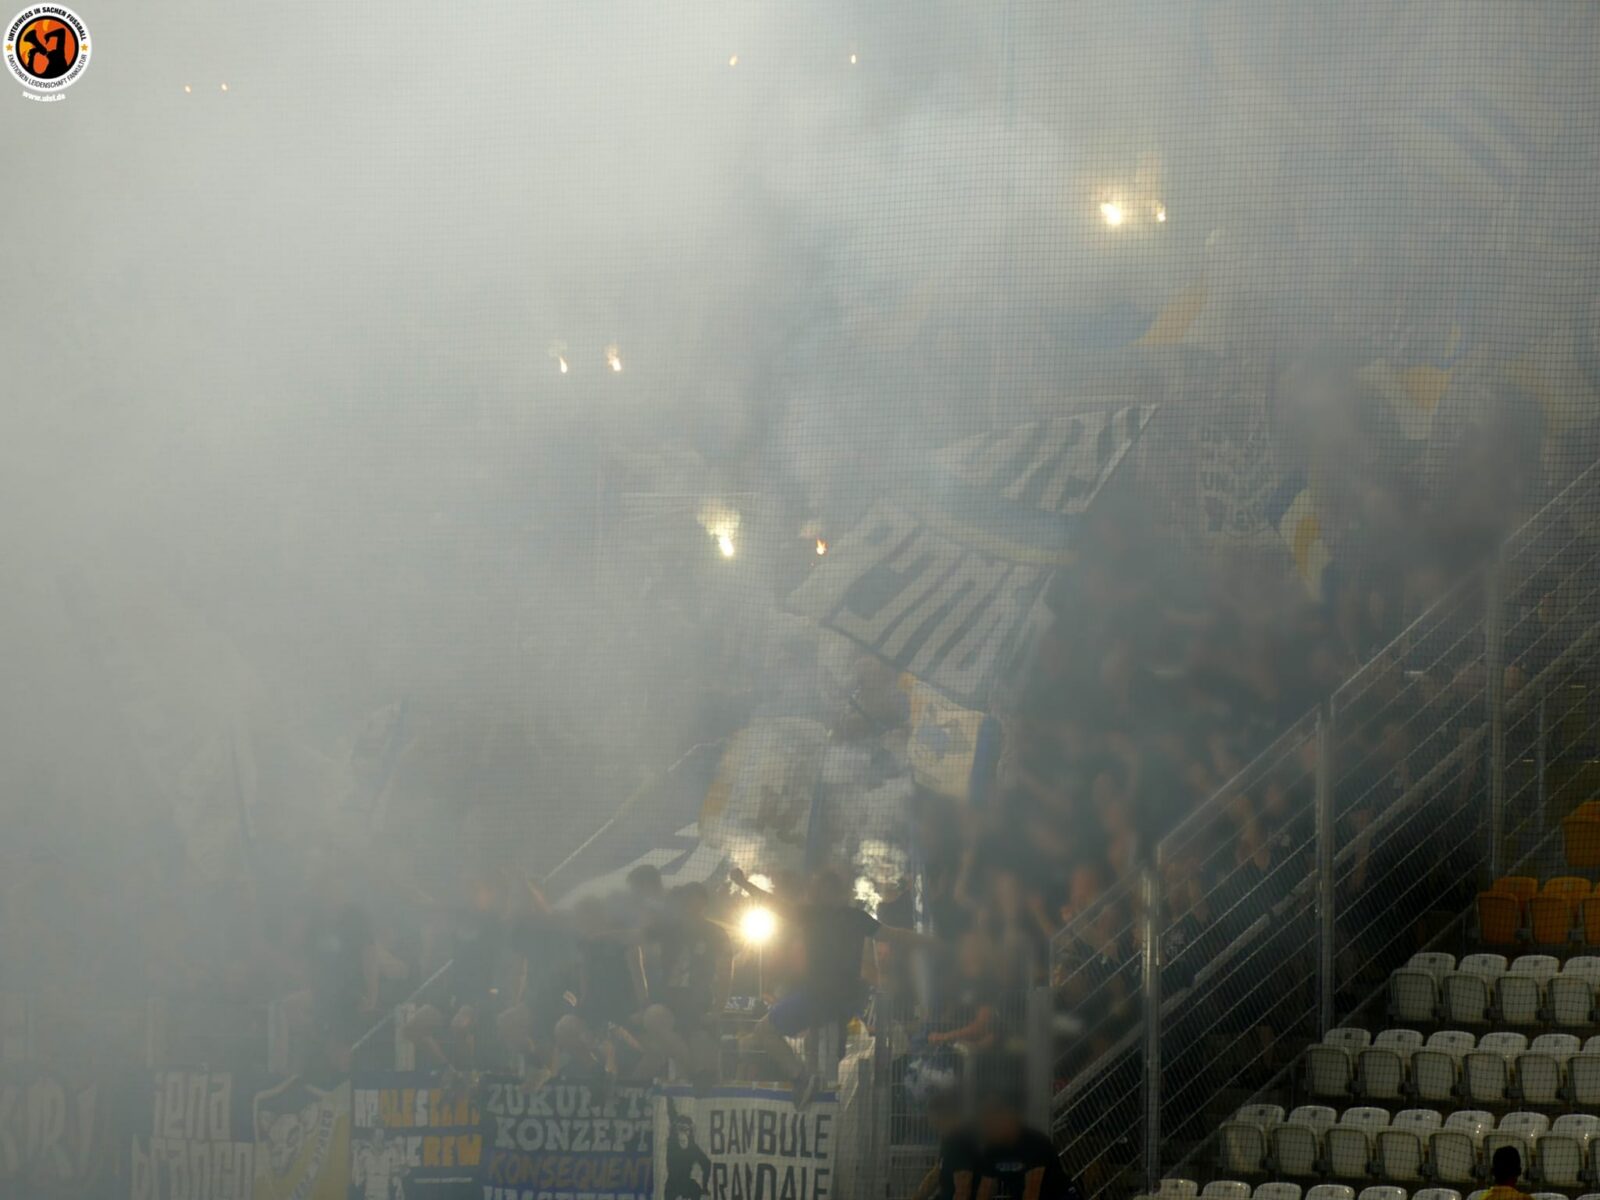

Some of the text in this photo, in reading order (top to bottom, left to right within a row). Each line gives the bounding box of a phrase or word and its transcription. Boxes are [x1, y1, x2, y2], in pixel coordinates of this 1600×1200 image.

[496, 1117, 653, 1152] KONZEPT
[710, 1109, 832, 1159] BAMBULE
[488, 1152, 654, 1191] KONSEQUENT
